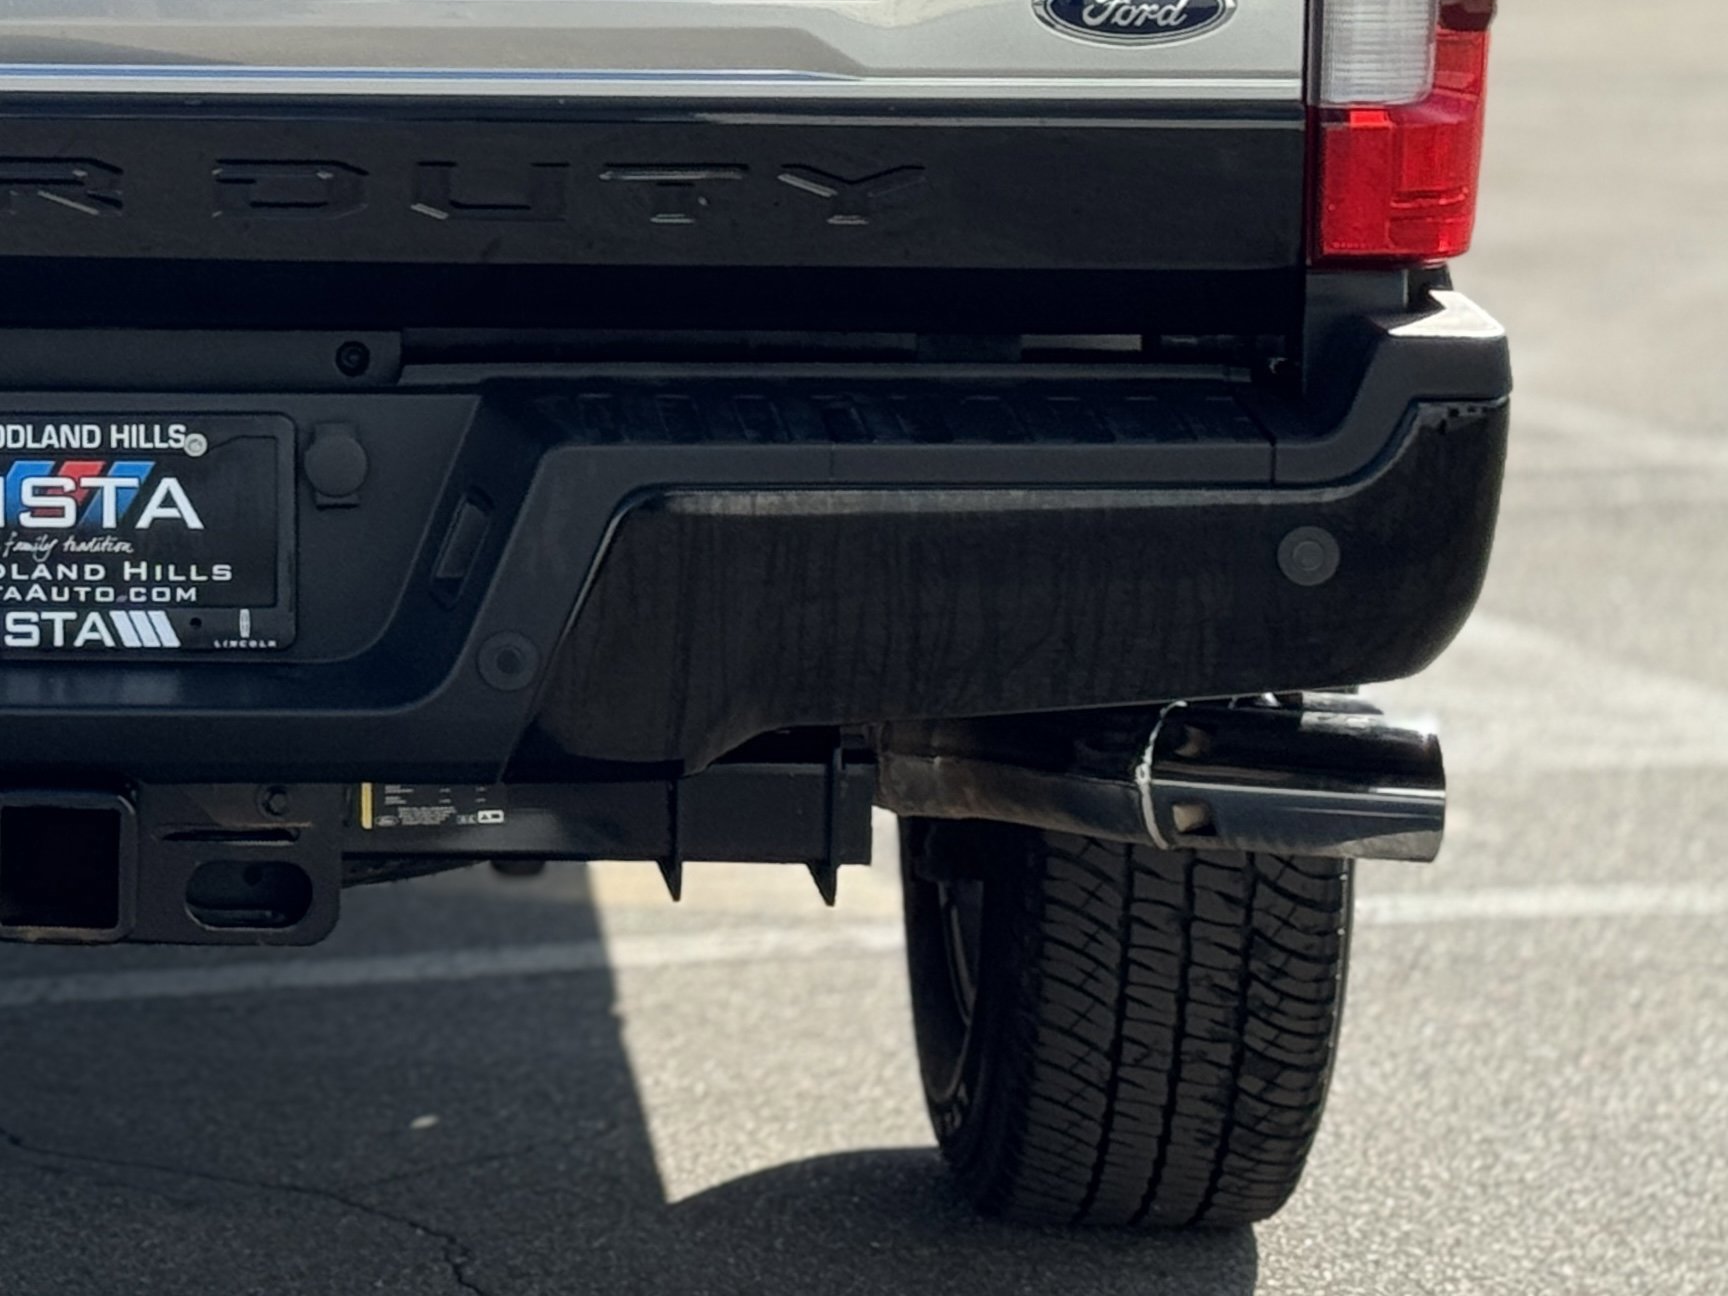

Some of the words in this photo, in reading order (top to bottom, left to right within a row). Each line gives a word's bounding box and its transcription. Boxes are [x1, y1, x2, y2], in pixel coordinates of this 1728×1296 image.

[213, 157, 927, 224] DUTY
[110, 424, 187, 450] HILLS
[2, 531, 59, 563] family
[62, 534, 135, 554] tradition
[123, 560, 233, 581] HILLS
